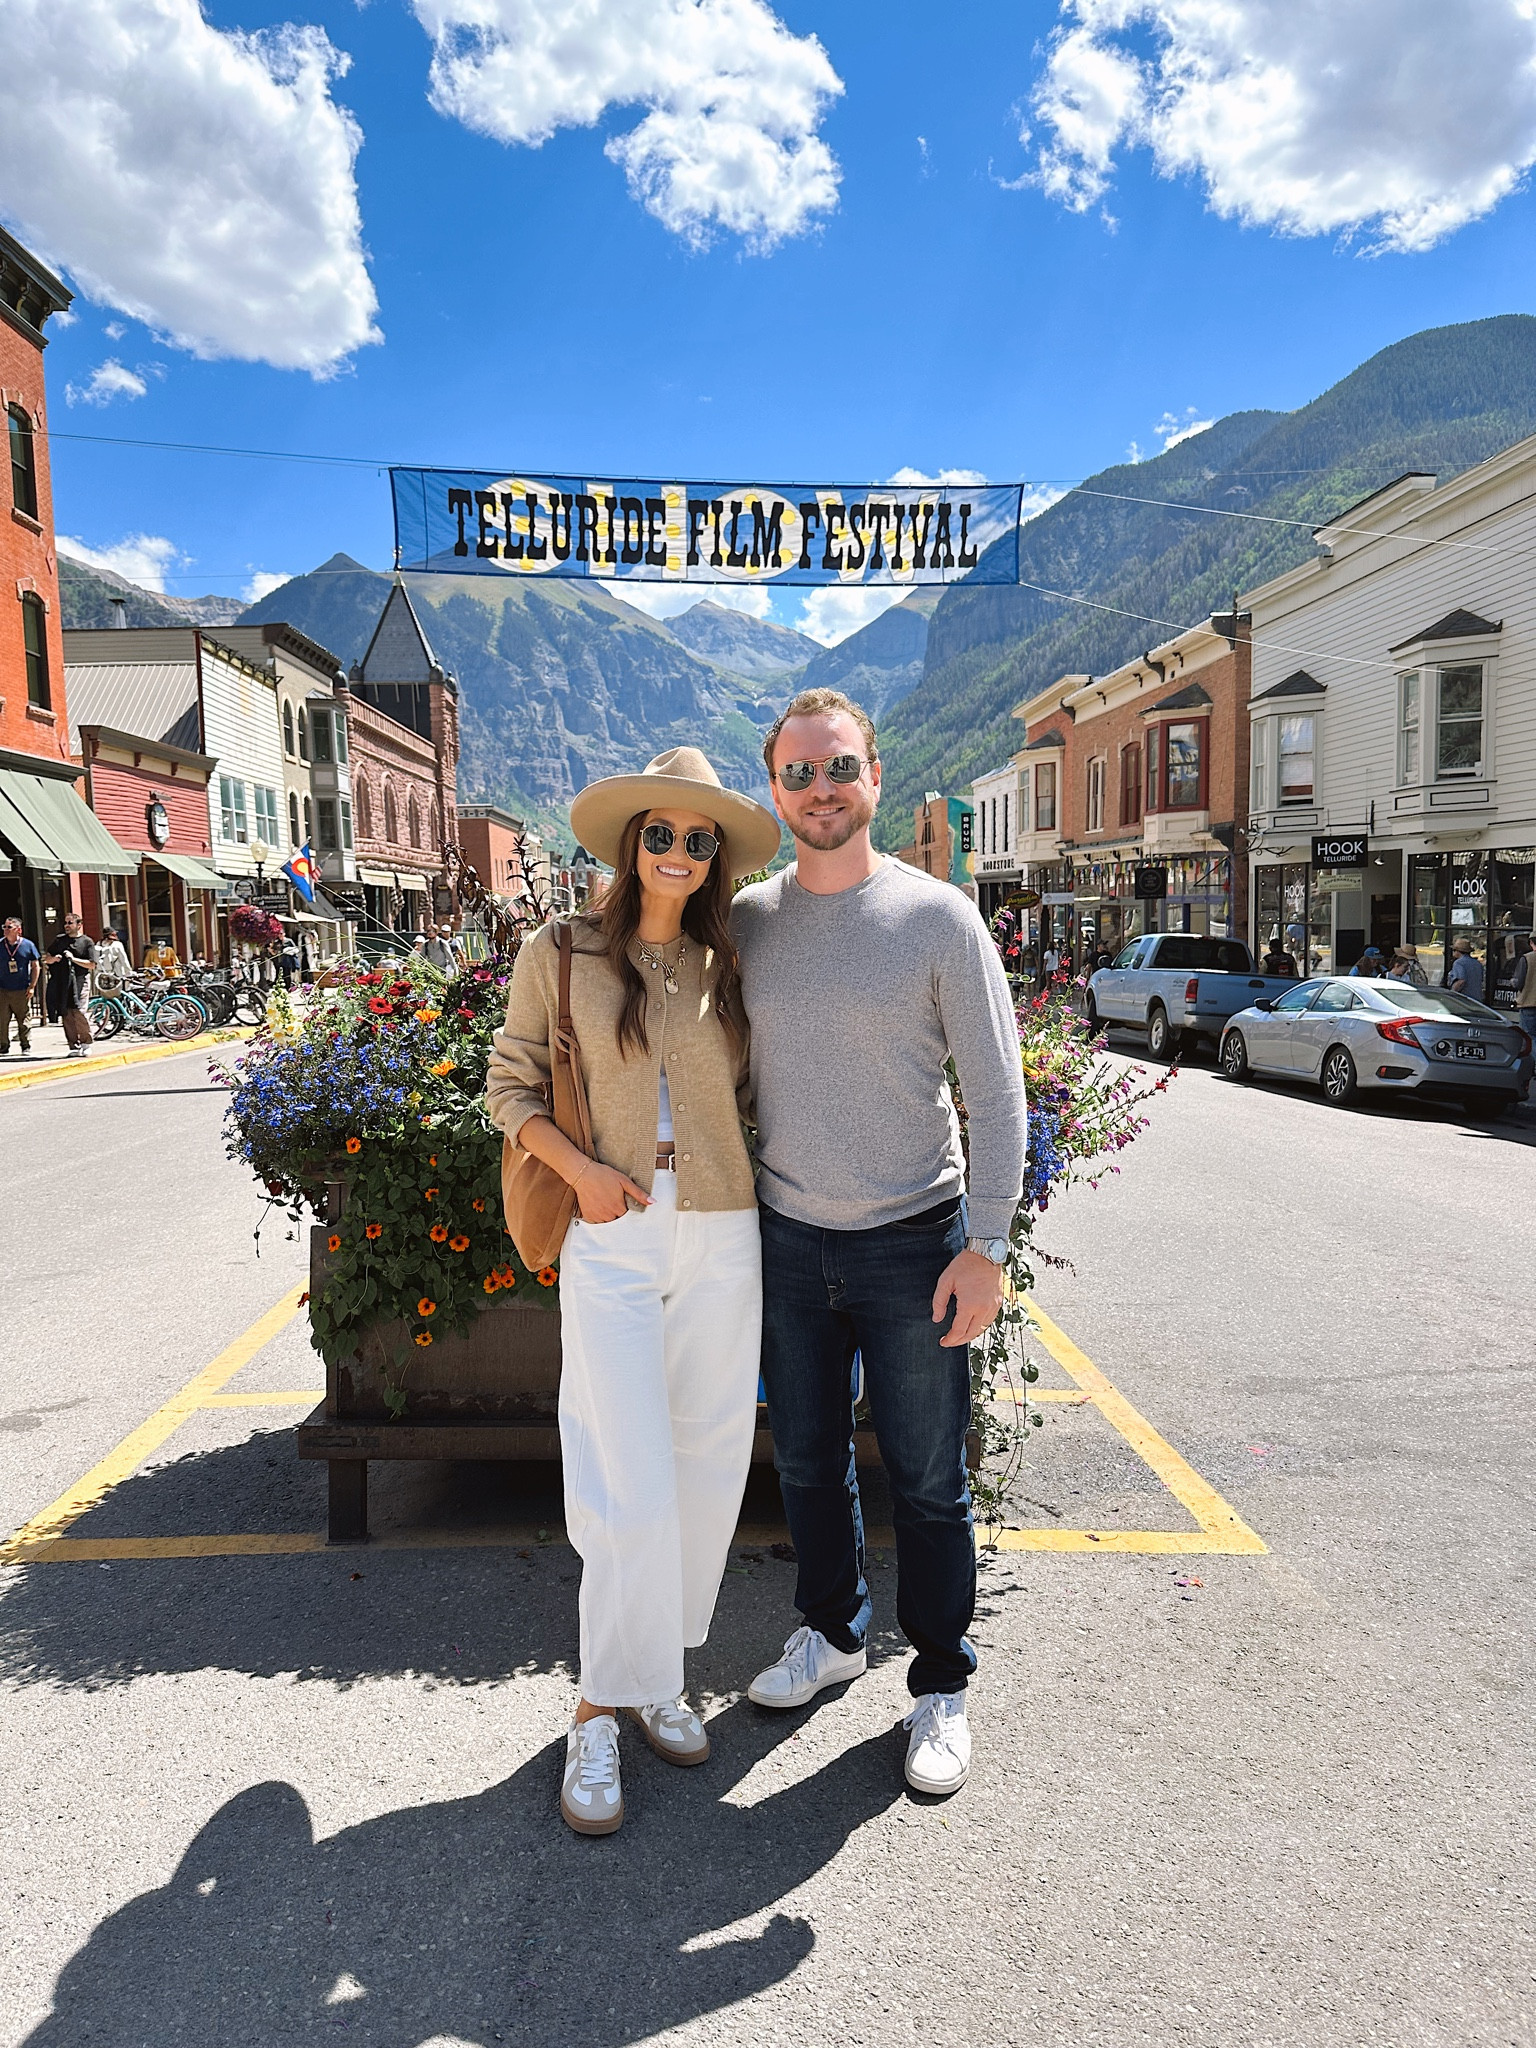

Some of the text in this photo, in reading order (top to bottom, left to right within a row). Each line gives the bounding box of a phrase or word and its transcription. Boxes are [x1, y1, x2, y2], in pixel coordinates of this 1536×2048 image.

[448, 488, 978, 570] TELLURIDE FILM FESTIVAL
[962, 816, 970, 850] BRUNO
[1317, 841, 1364, 856] HOOK
[982, 858, 1015, 871] BOOKSTORE
[1323, 855, 1357, 863] TELLURIDE
[1284, 885, 1306, 898] HOOK
[1453, 879, 1487, 895] HOOK
[1494, 989, 1518, 1002] ART/FRA
